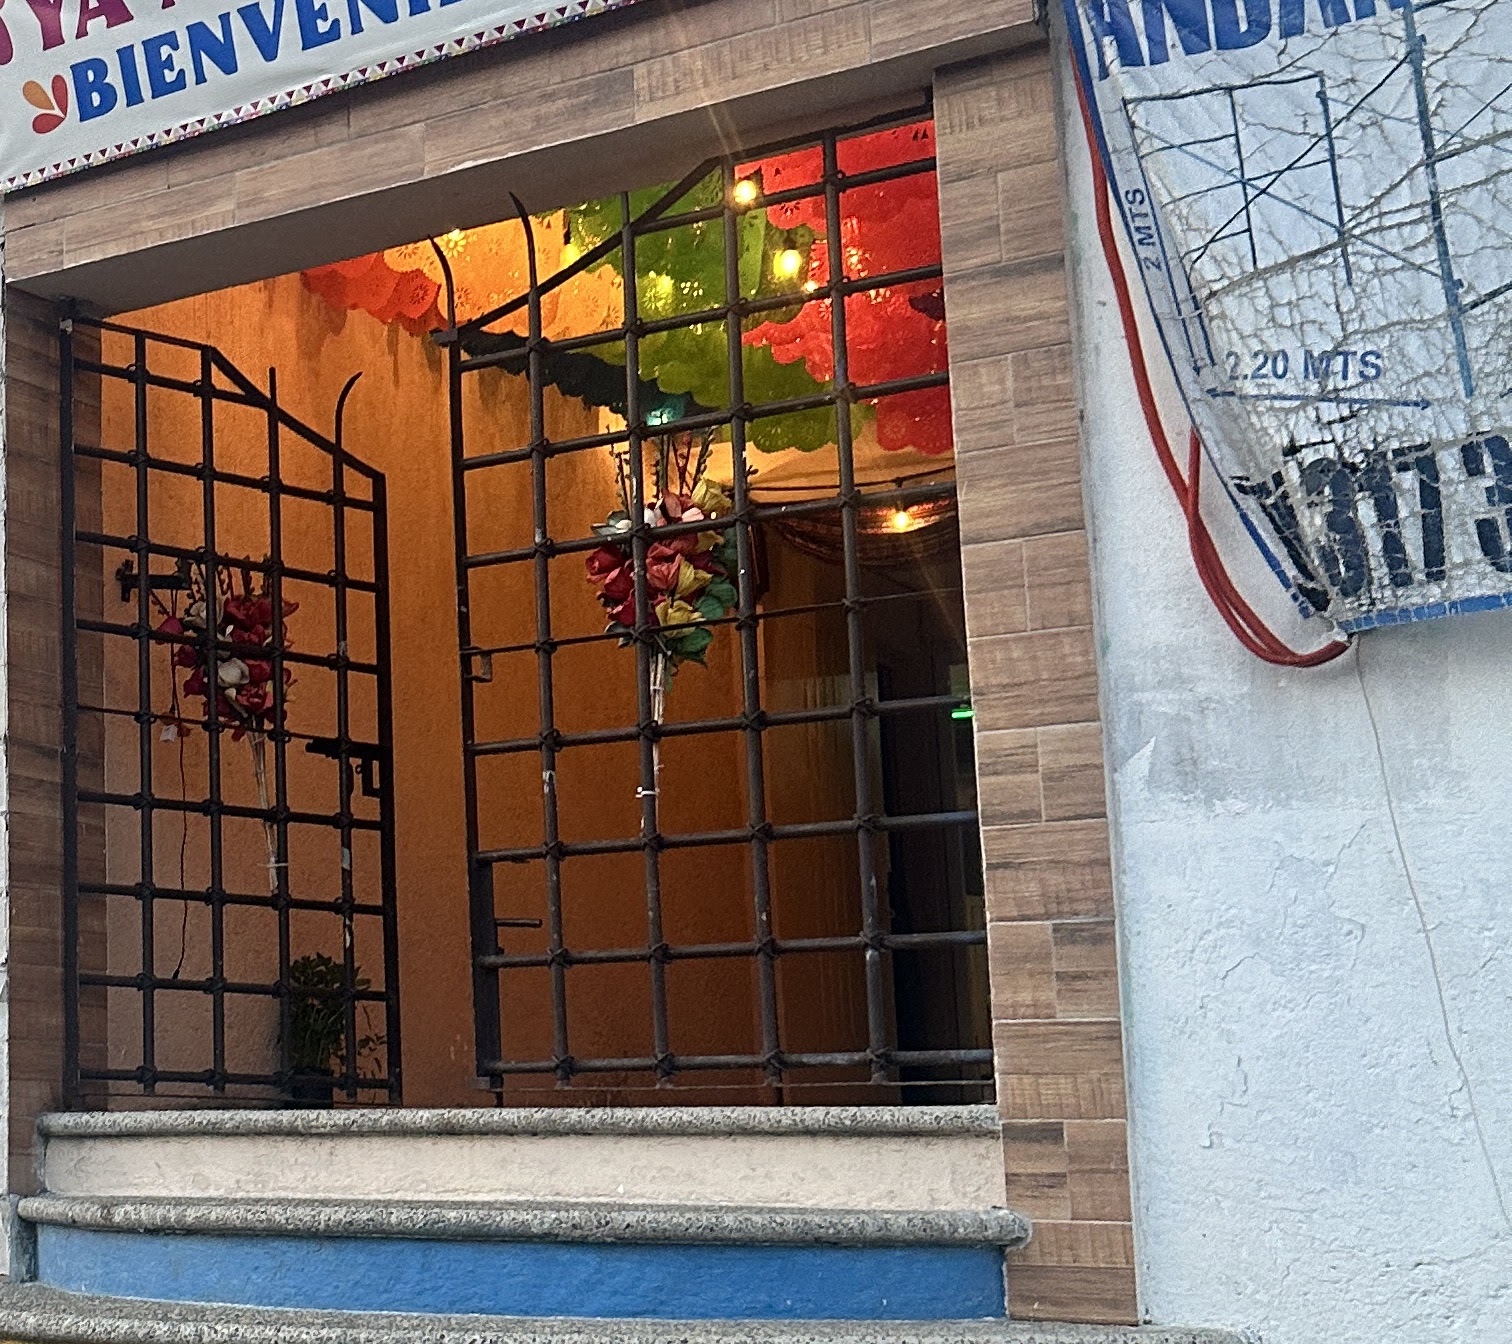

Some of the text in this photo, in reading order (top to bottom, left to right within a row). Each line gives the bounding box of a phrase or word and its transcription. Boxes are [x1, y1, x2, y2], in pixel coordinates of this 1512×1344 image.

[1125, 187, 1156, 248] MTS
[1224, 349, 1383, 382] 2.20 MTS
